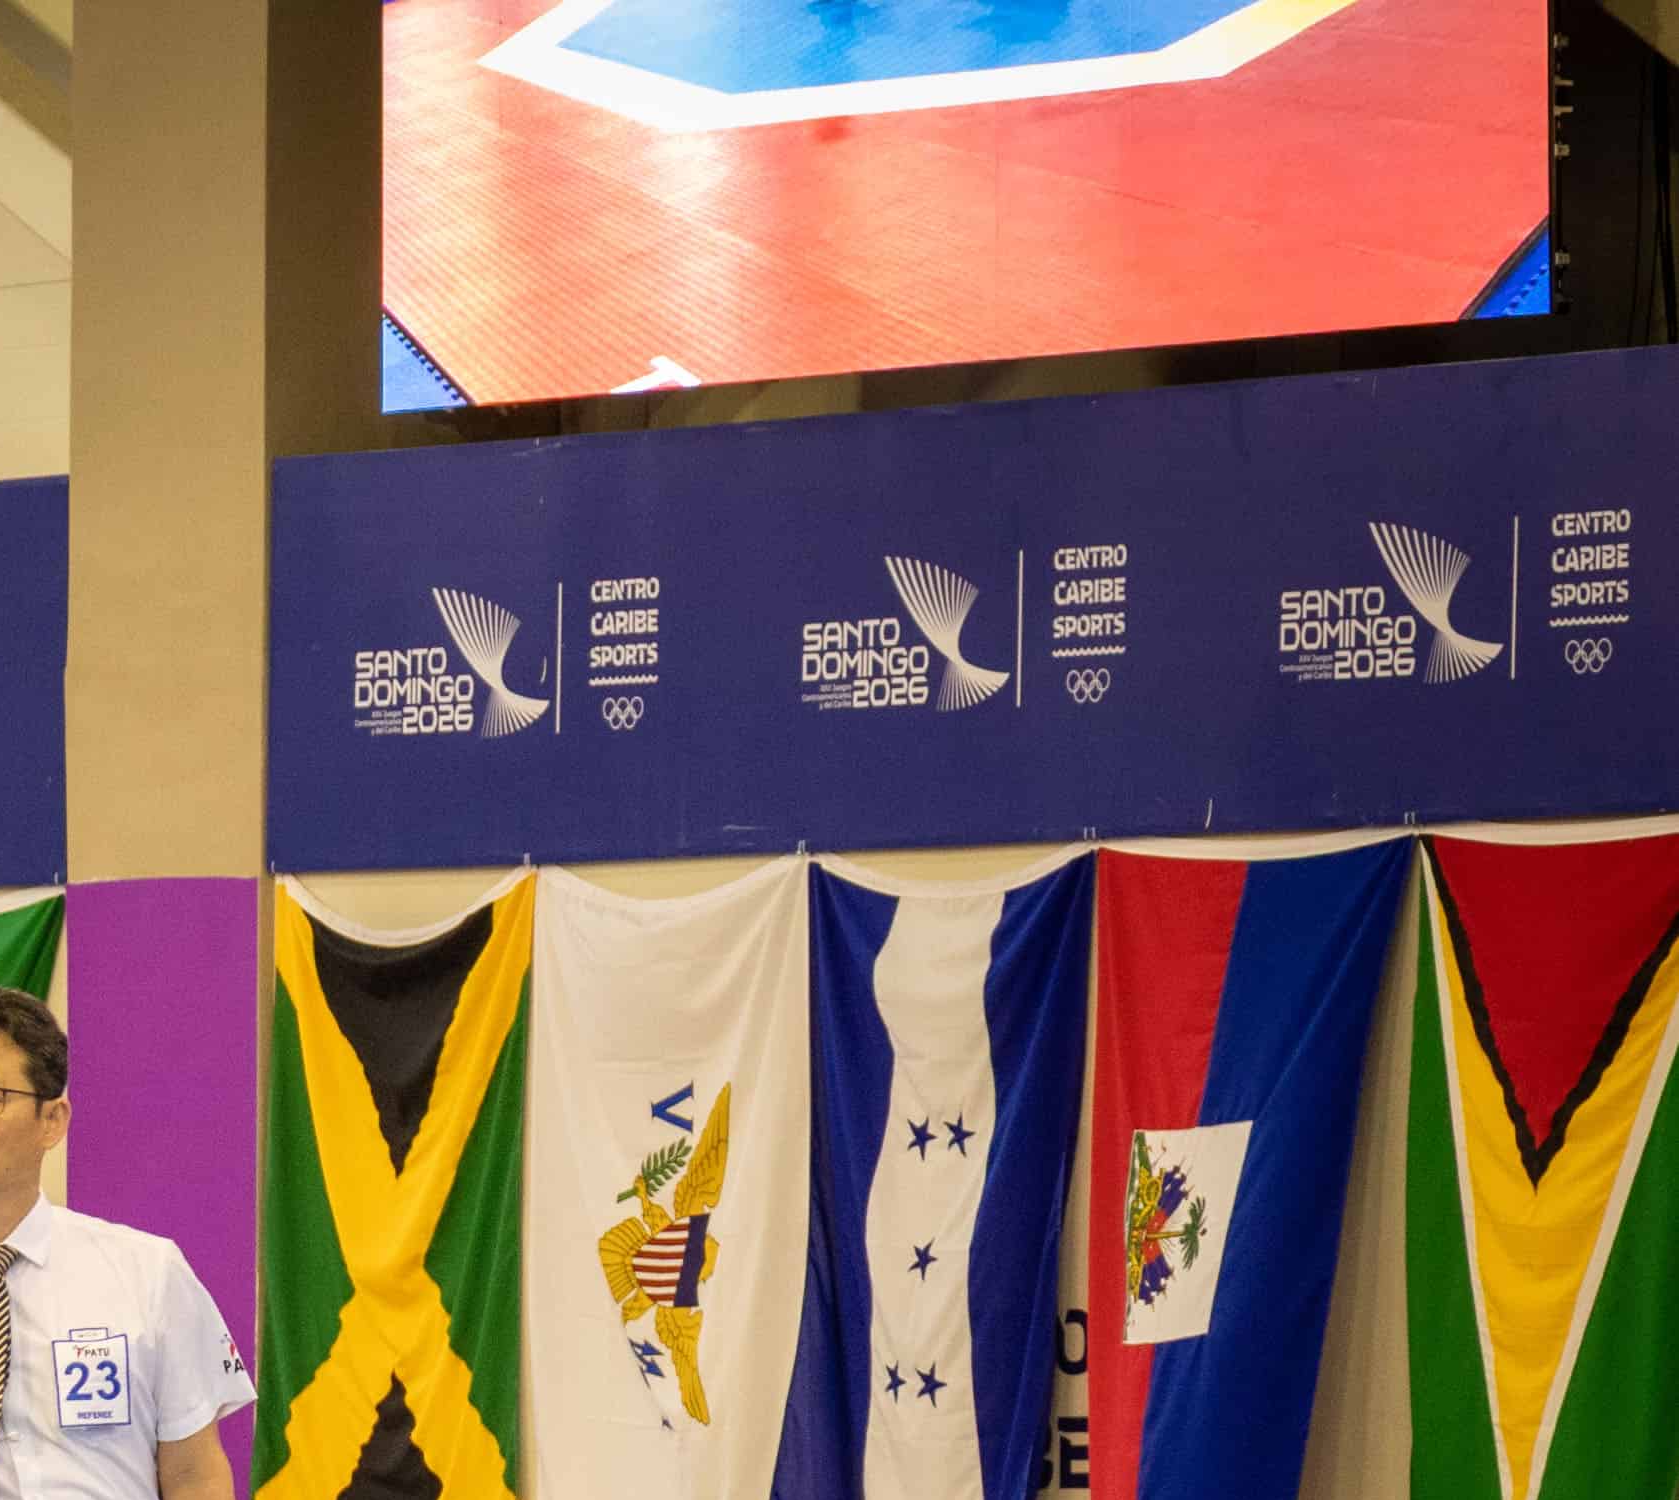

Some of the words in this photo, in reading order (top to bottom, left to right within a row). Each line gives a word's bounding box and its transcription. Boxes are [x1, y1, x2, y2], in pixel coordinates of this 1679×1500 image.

[1552, 509, 1630, 537] CENTRO
[1054, 544, 1127, 571] CENTRO
[1552, 543, 1630, 573] CARIBE
[591, 578, 660, 602] CENTRO
[1054, 577, 1126, 606] CARIBE
[1280, 586, 1384, 621] SANTO
[1550, 580, 1628, 608] SPORTS
[591, 609, 659, 636] CARIBE
[803, 618, 900, 652] SANTO
[1053, 613, 1125, 639] SPORTS
[1279, 616, 1416, 652] DOMINGO
[355, 647, 446, 679] SANTO
[590, 643, 659, 667] SPORTS
[802, 647, 929, 682] DOMINGO
[1334, 647, 1416, 680] 2026
[355, 675, 474, 708] DOMINGO
[853, 677, 928, 708] 2026
[403, 704, 474, 734] 2026
[84, 1347, 110, 1358] PATU
[223, 1358, 244, 1374] PA
[64, 1360, 121, 1401] 23
